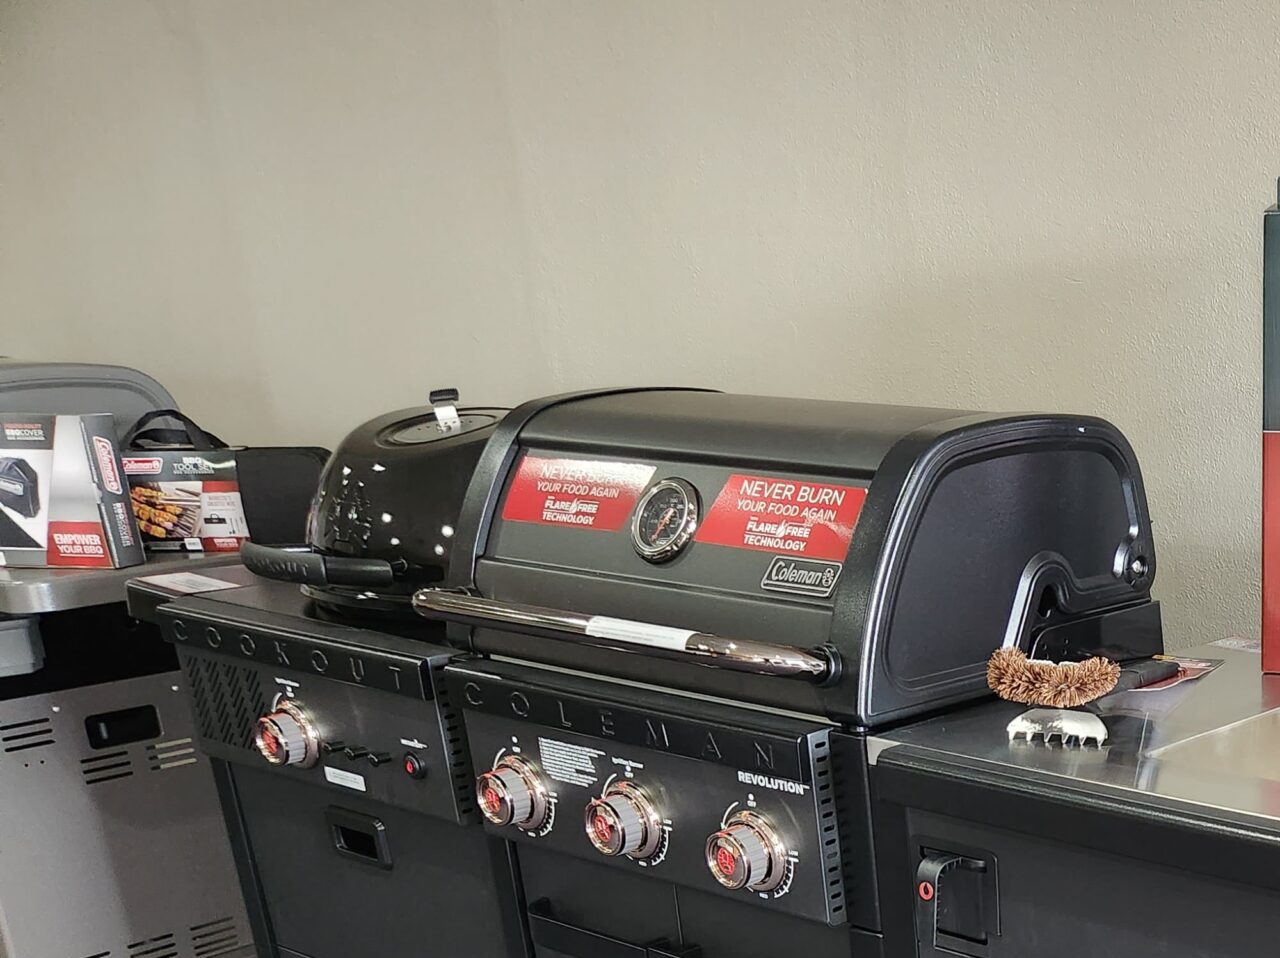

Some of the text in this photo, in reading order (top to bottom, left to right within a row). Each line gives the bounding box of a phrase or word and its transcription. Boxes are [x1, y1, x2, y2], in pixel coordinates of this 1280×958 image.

[173, 463, 197, 471] TOOL
[541, 463, 584, 481] NEVER
[537, 481, 619, 499] YOUR FOOD AGAIN
[739, 479, 846, 506] NEVER BURN
[545, 499, 599, 514] FLARE FREE
[737, 498, 837, 522] YOUR FOOD AGAIN
[542, 511, 595, 525] TECHNOLOGY
[746, 521, 811, 538] FLARE FREE
[53, 533, 101, 546] EMPOWER
[744, 534, 807, 551] TECHNOLOGY
[58, 544, 104, 554] YOUR BBQ
[771, 561, 822, 585] Coleman
[464, 682, 774, 769] COLEMAN
